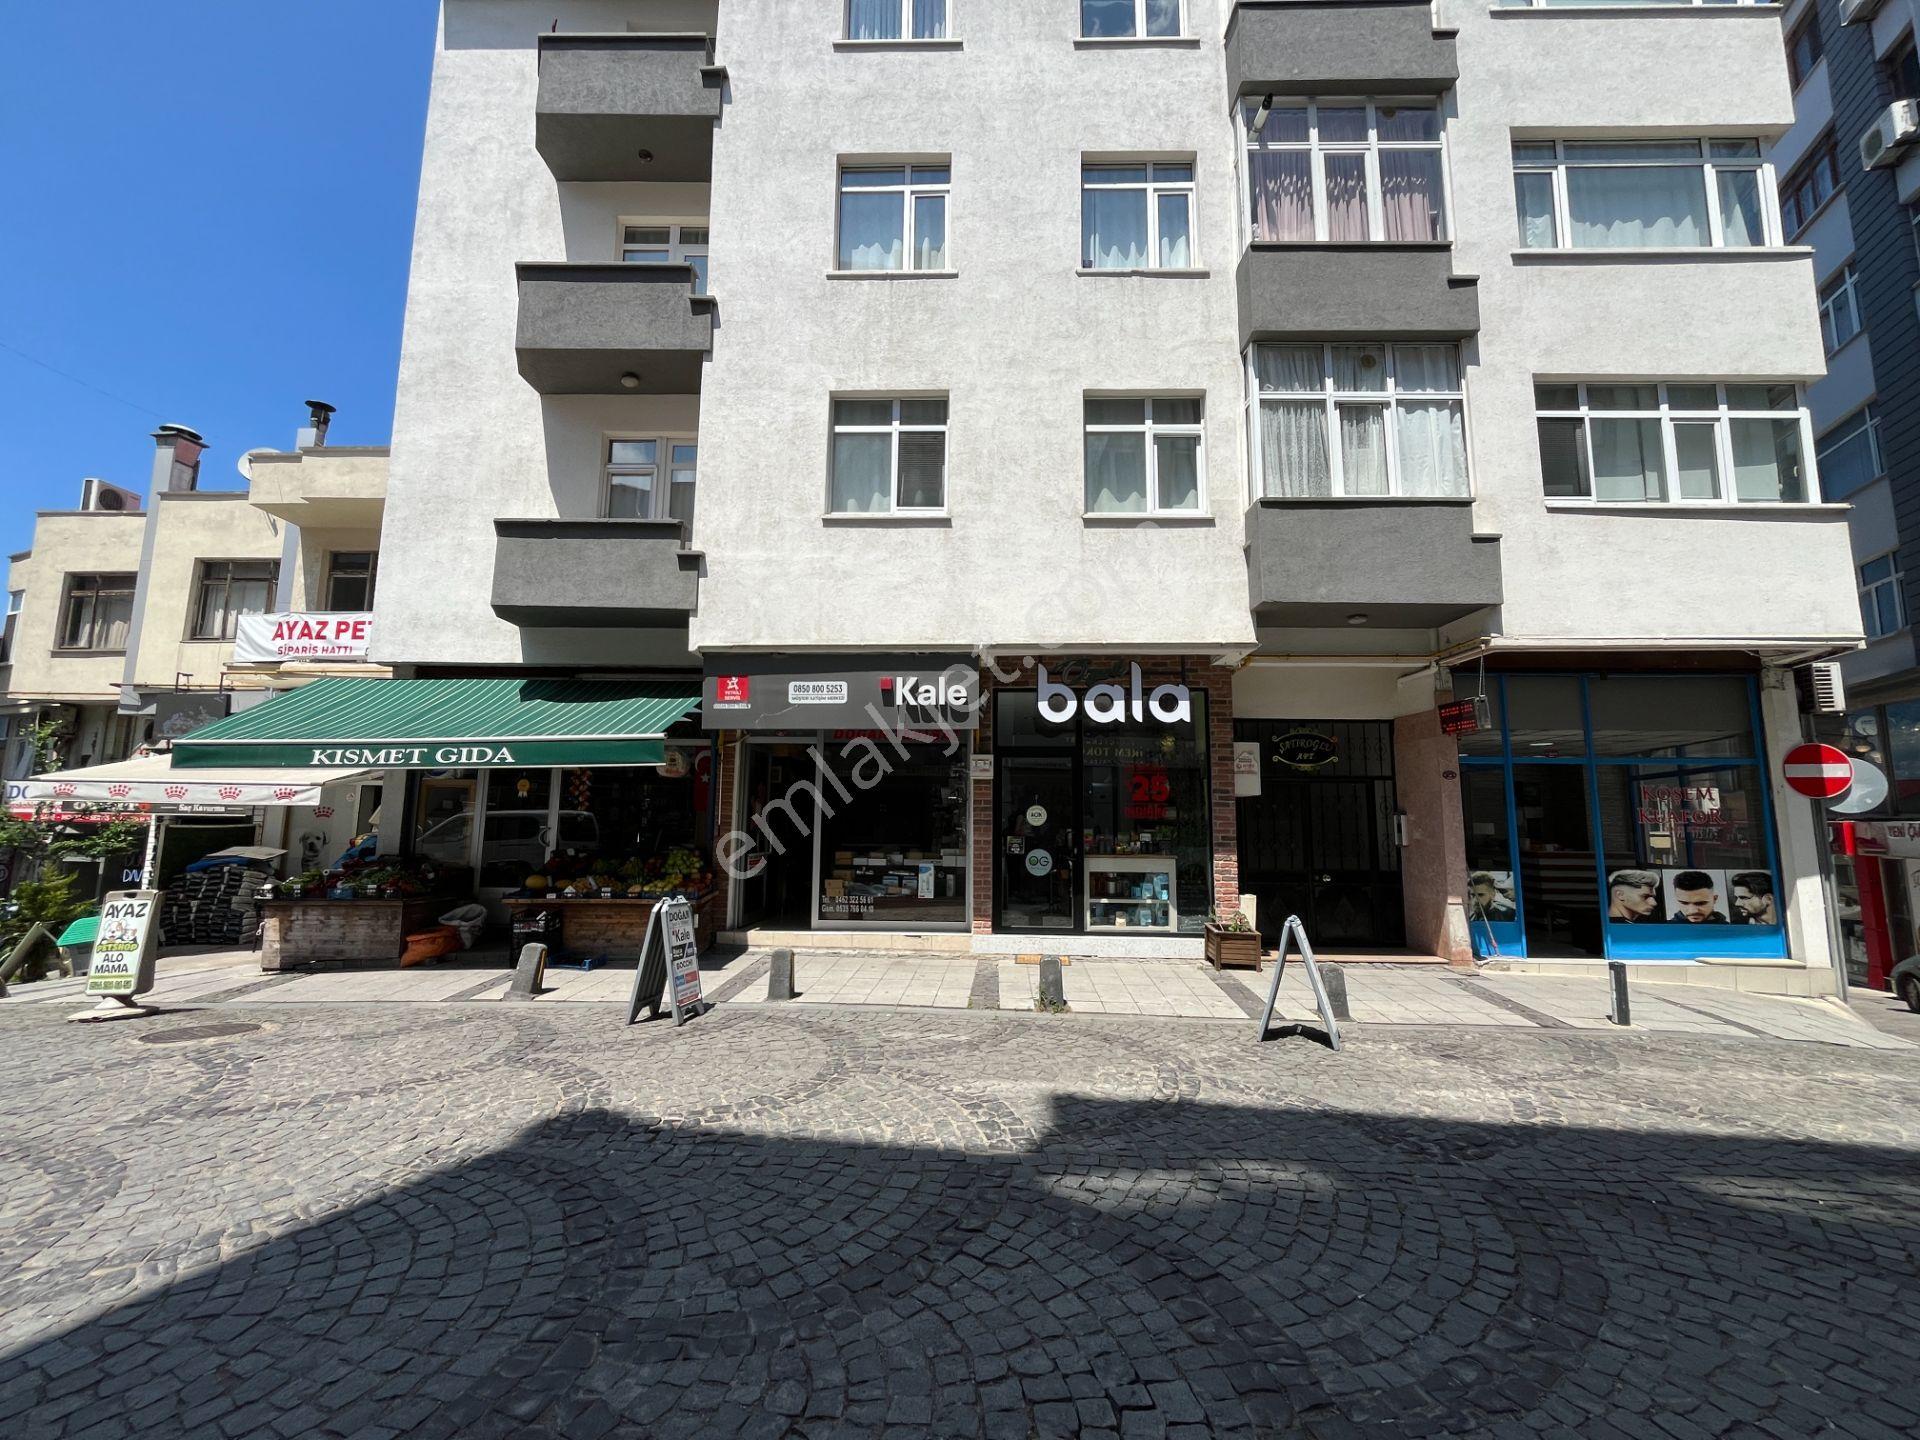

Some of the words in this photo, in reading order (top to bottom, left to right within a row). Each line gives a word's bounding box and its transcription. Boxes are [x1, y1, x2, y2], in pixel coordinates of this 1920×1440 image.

[272, 621, 329, 640] AYAZ
[322, 645, 352, 655] HATTI
[793, 684, 811, 693] 0850
[812, 684, 825, 693] 800
[826, 684, 843, 693] 5253
[895, 676, 968, 706] Kale
[1037, 661, 1190, 723] bala
[310, 749, 427, 765] KISMET
[435, 746, 515, 763] GIDA
[104, 903, 148, 918] AYAZ
[674, 928, 690, 942] Kale
[103, 953, 124, 963] ALO
[95, 963, 129, 974] MAMA
